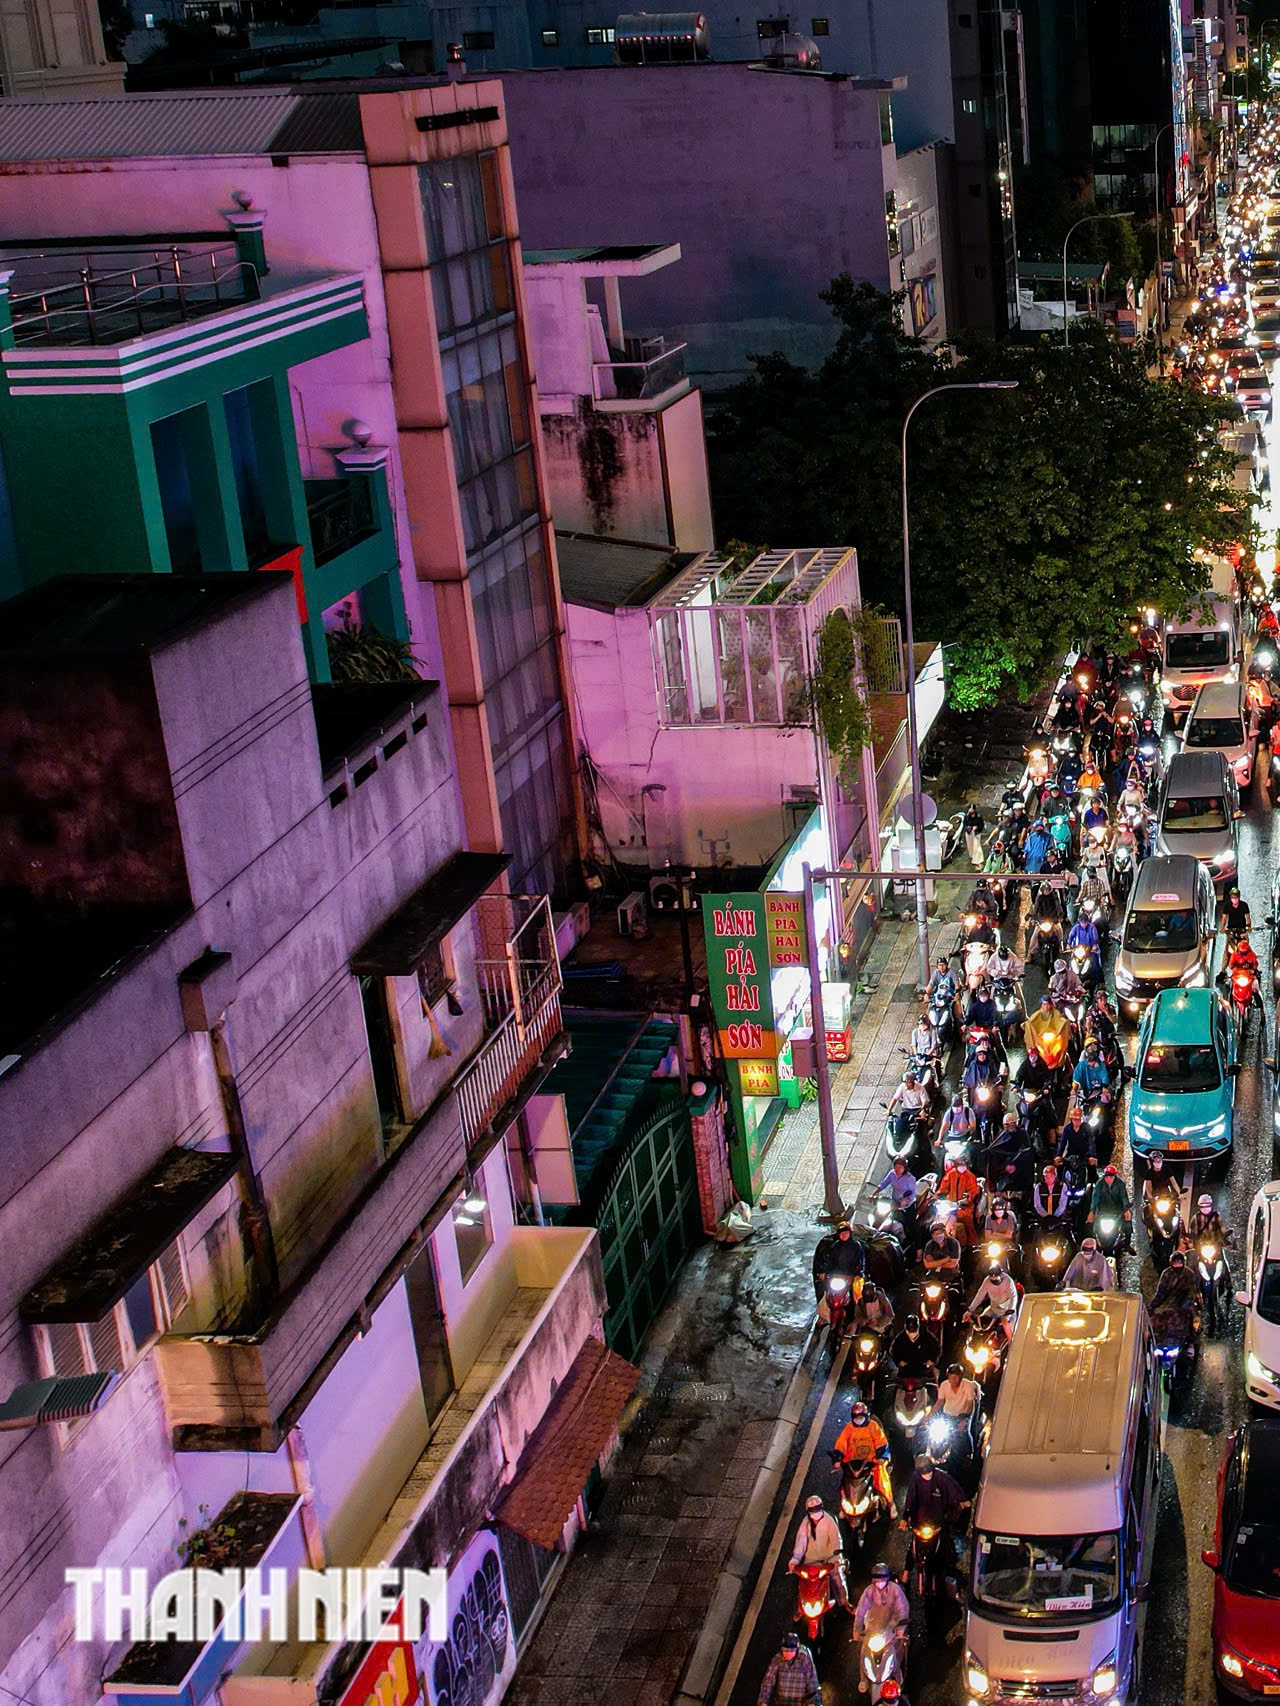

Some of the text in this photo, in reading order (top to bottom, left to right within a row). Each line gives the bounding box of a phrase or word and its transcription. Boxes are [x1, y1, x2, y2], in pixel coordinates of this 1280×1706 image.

[713, 901, 756, 936] BÁNH
[774, 916, 797, 930] PÍA
[775, 932, 799, 947] HẢI
[725, 941, 757, 975] PÍA
[775, 951, 800, 963] SƠN
[726, 975, 760, 1010] HẢI
[728, 1020, 762, 1049] SƠN
